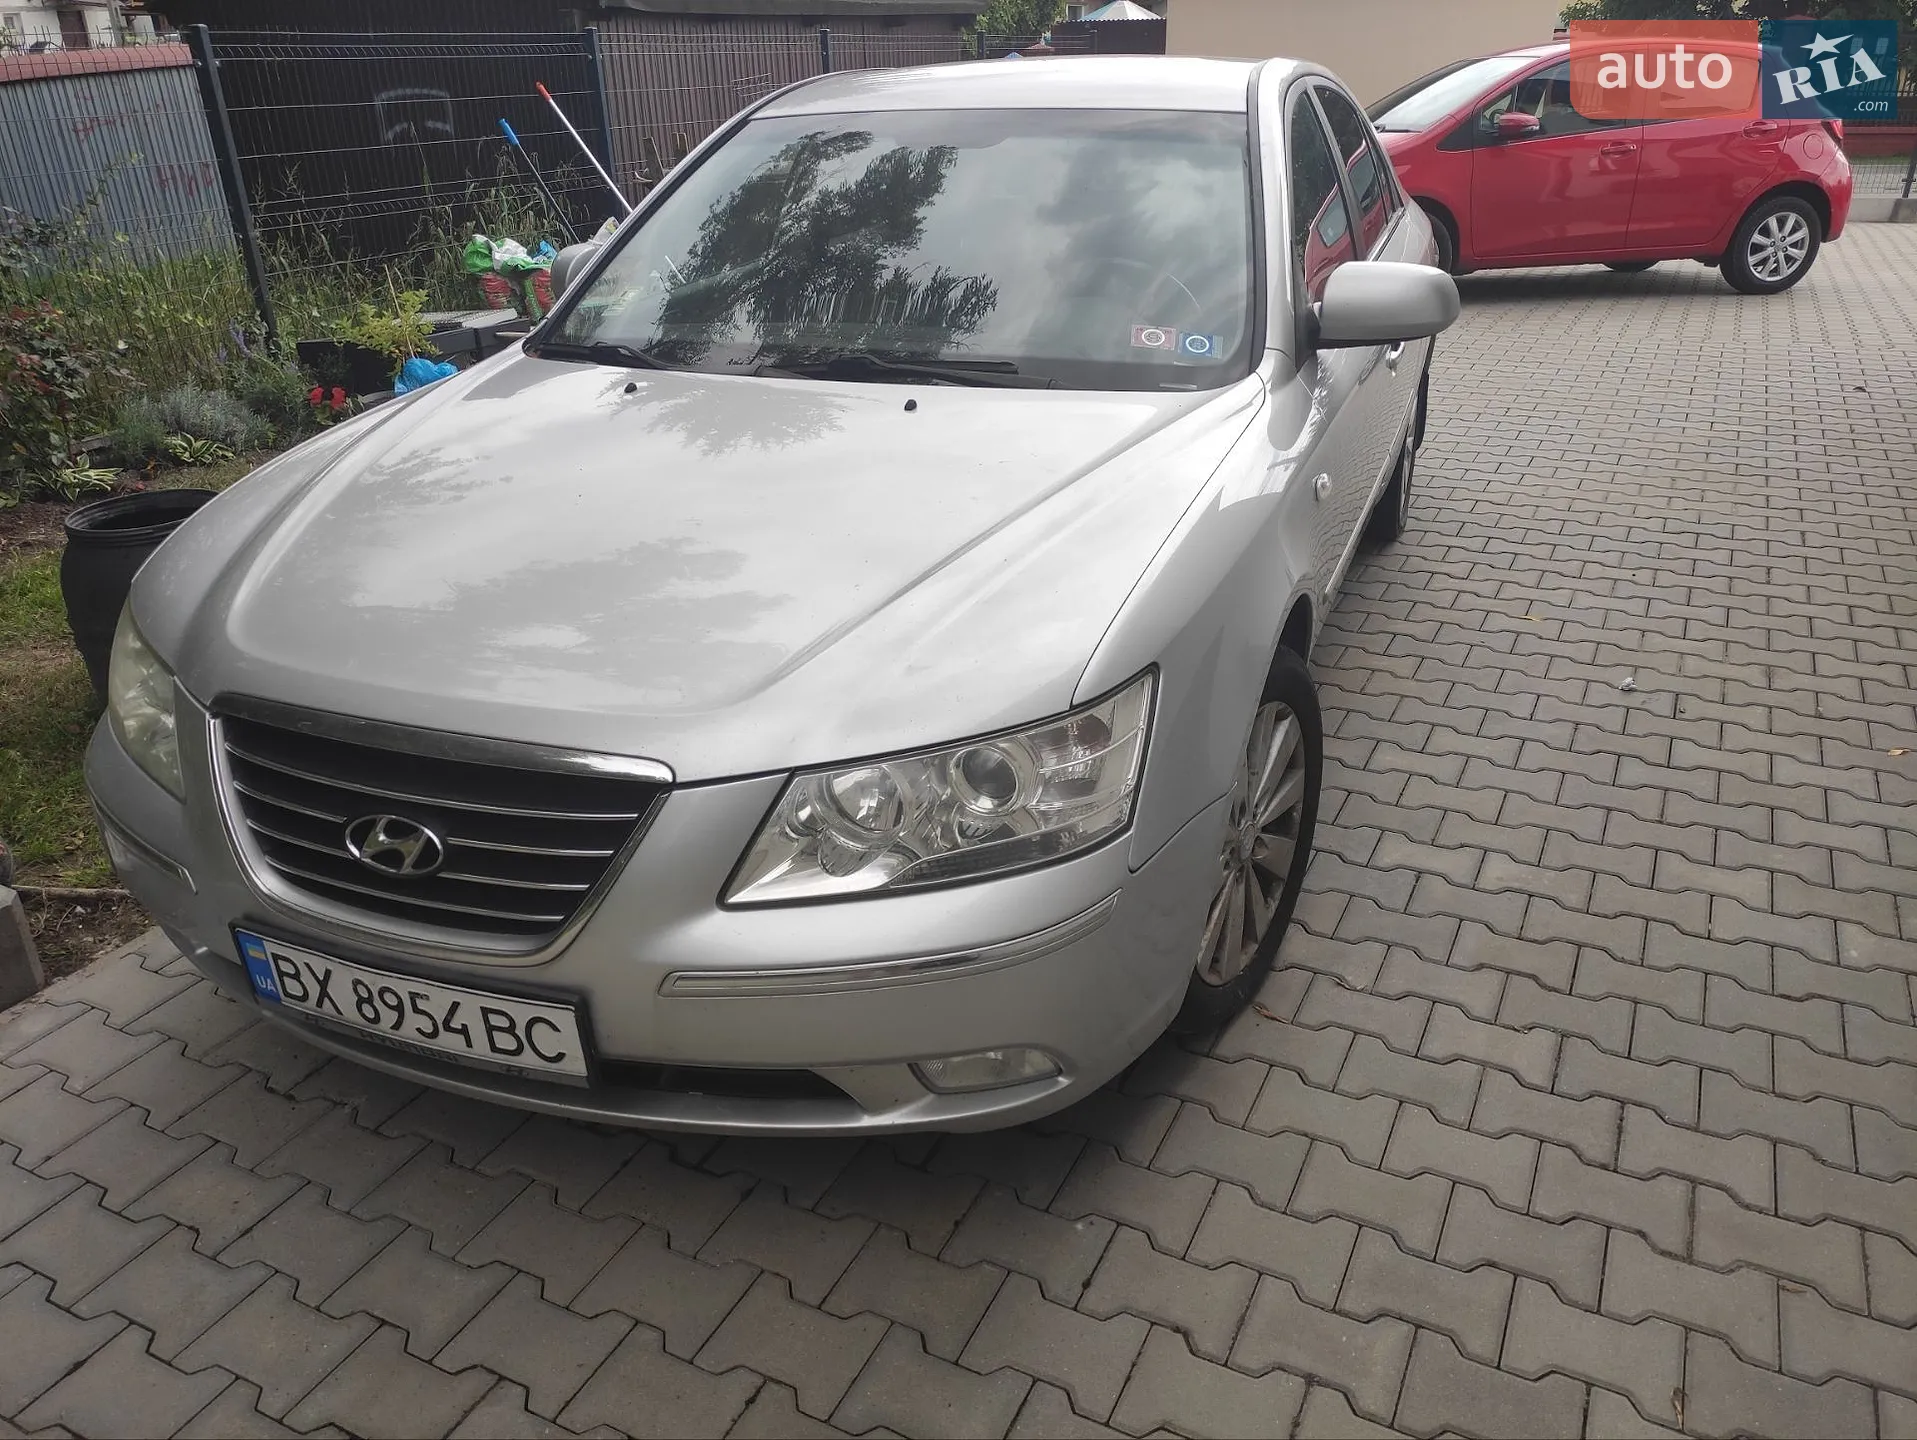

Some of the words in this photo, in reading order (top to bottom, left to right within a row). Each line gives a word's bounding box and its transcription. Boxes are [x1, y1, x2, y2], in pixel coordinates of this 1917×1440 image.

[256, 974, 277, 993] UA
[270, 952, 344, 1016] BX
[351, 977, 473, 1048] 8954
[480, 1005, 567, 1064] BC
